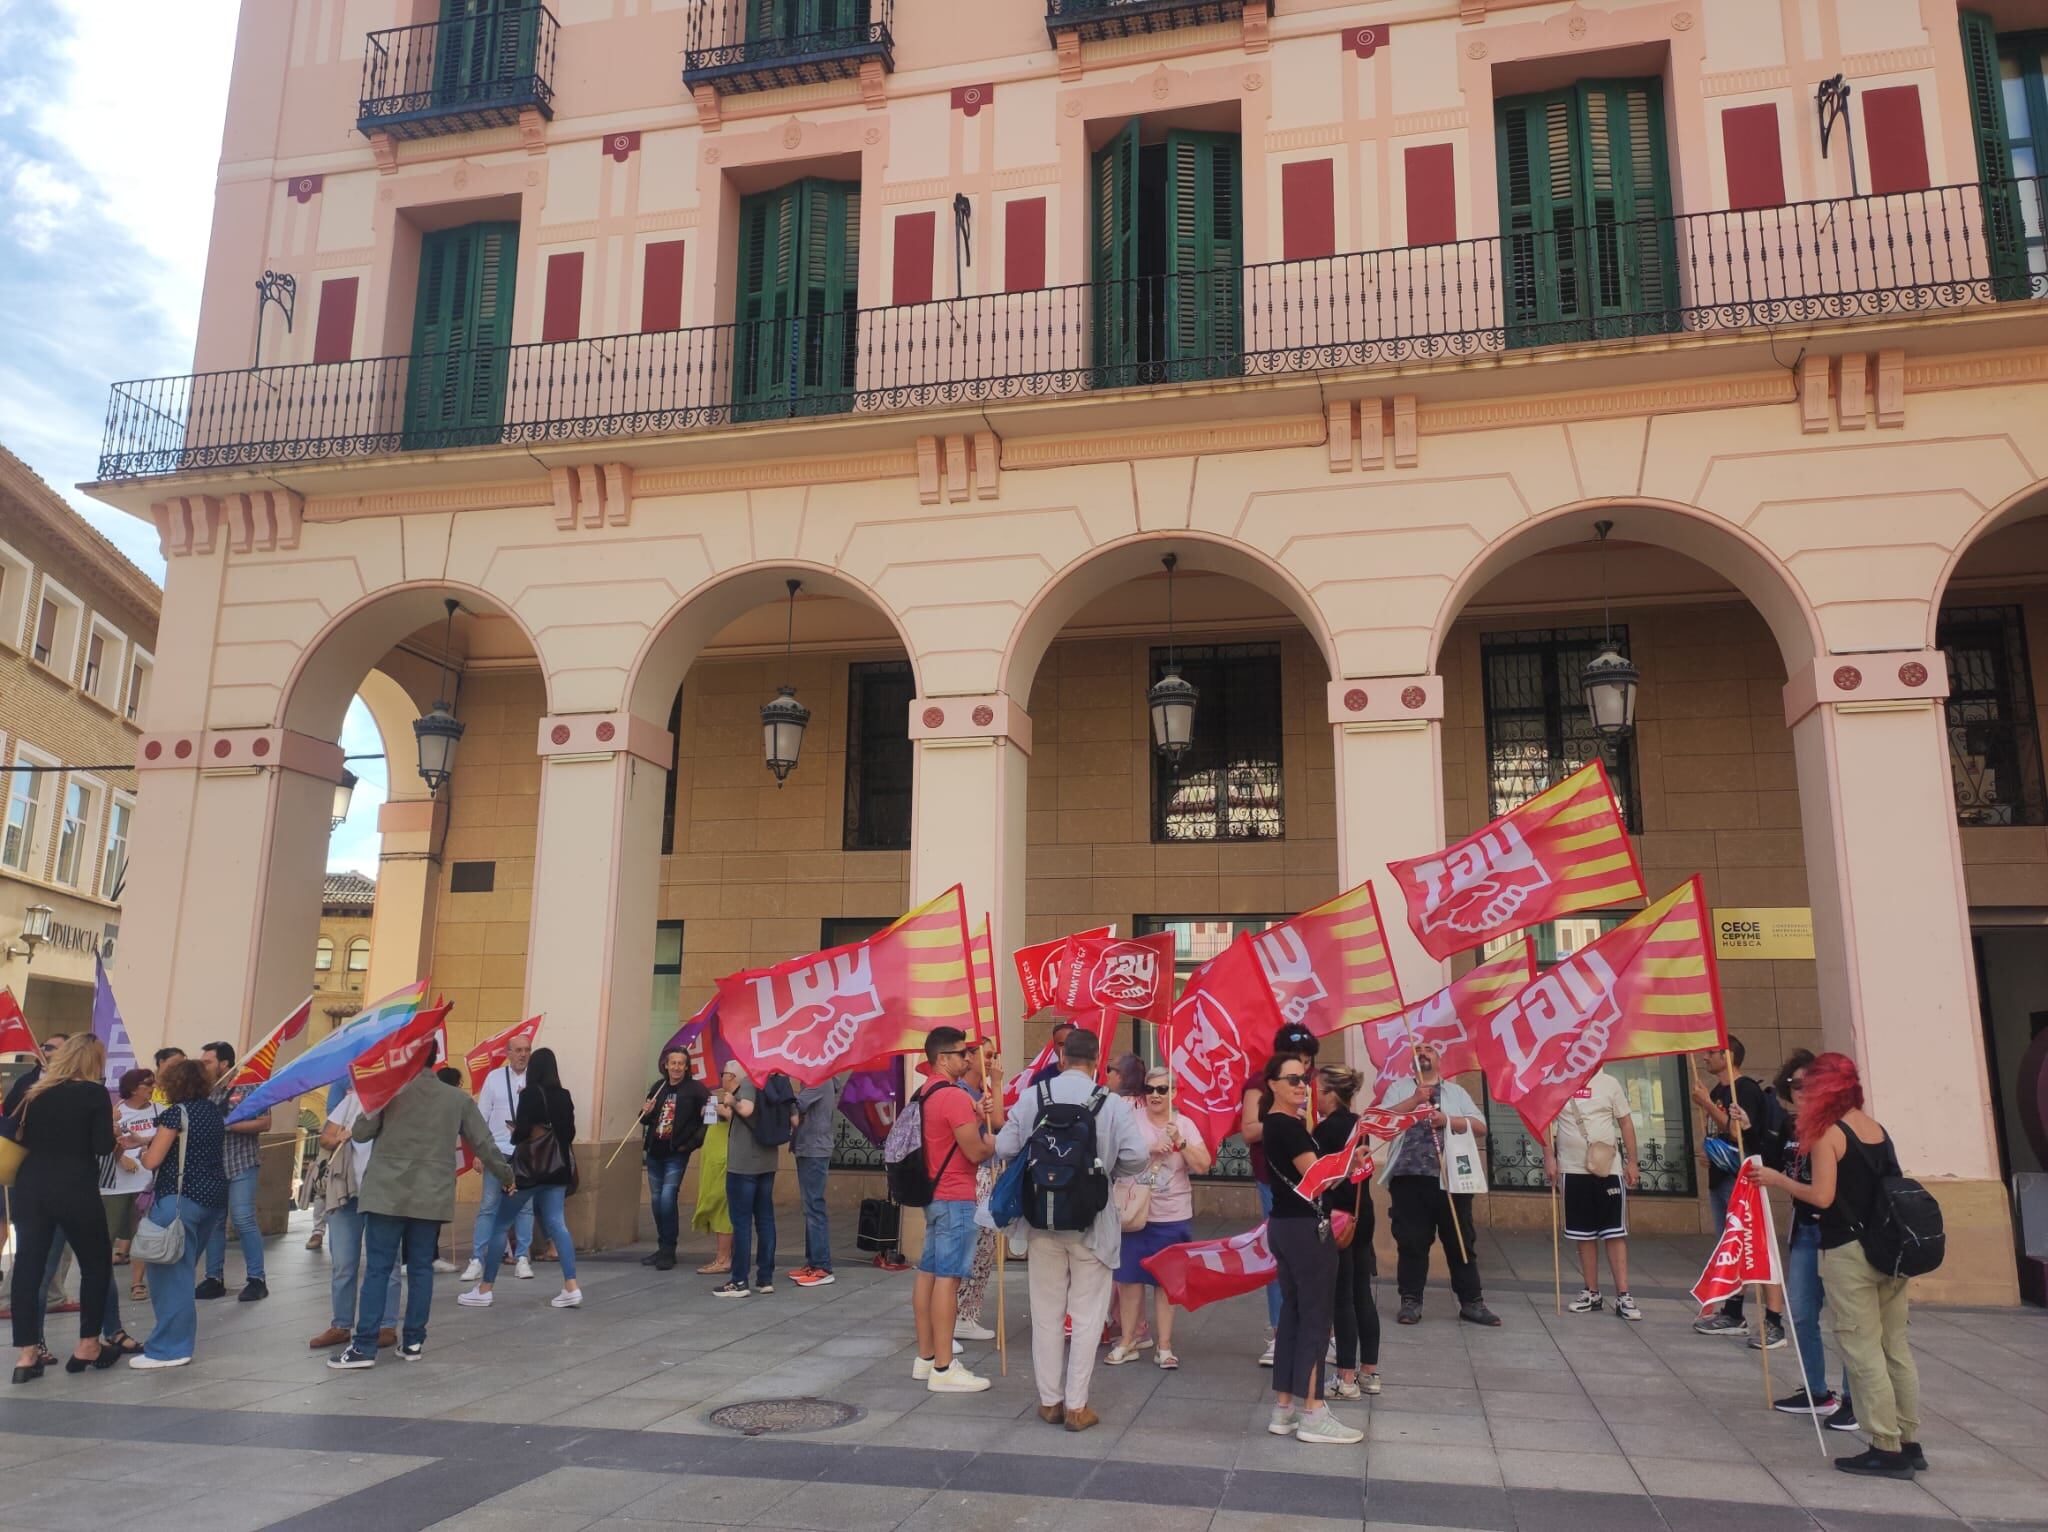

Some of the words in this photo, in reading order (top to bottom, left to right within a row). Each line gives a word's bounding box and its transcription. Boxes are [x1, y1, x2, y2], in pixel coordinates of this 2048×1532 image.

[1721, 921, 1760, 932] CEOE
[48, 921, 99, 953] UDIENCIA
[130, 1122, 153, 1132] PALES
